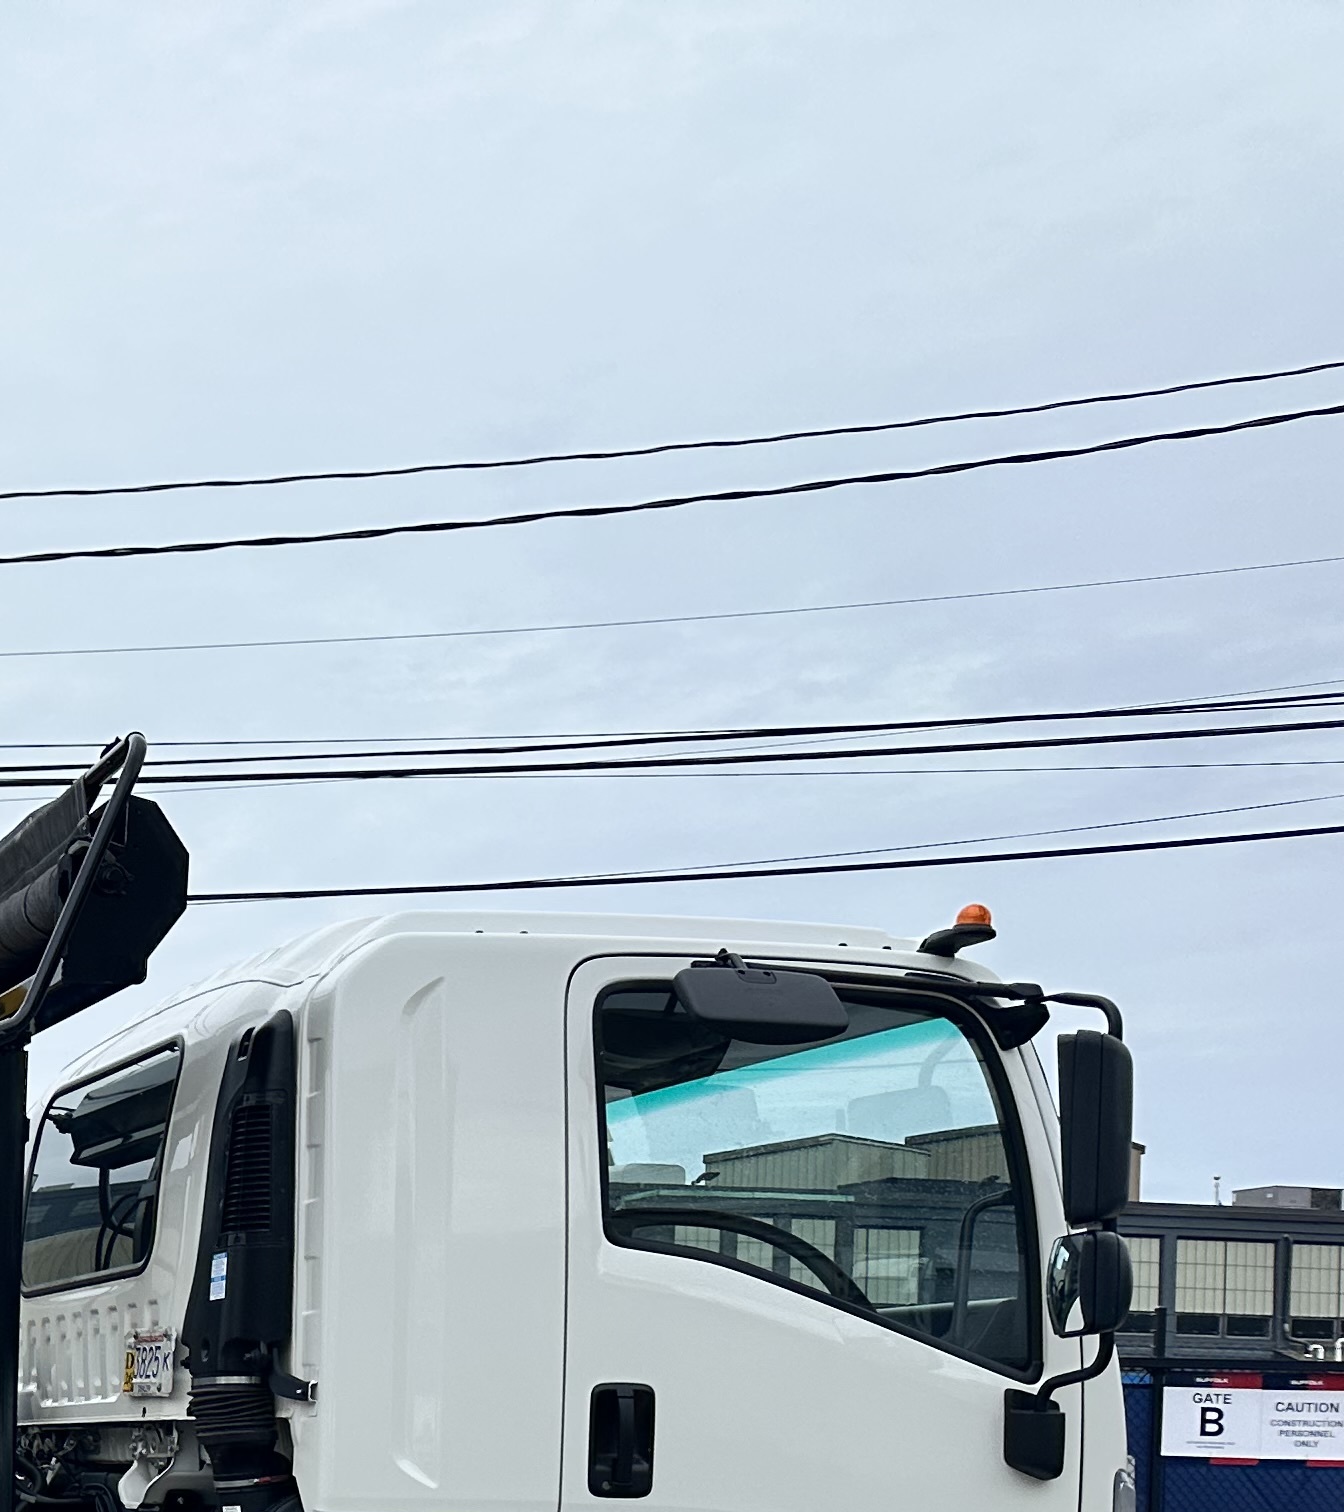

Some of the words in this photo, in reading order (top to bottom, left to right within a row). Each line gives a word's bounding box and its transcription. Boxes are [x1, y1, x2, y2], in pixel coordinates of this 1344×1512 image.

[1192, 1393, 1232, 1404] GATE
[1275, 1401, 1340, 1413] CAUTION
[1199, 1406, 1225, 1437] B
[1270, 1419, 1344, 1427] CONSTRUCTION
